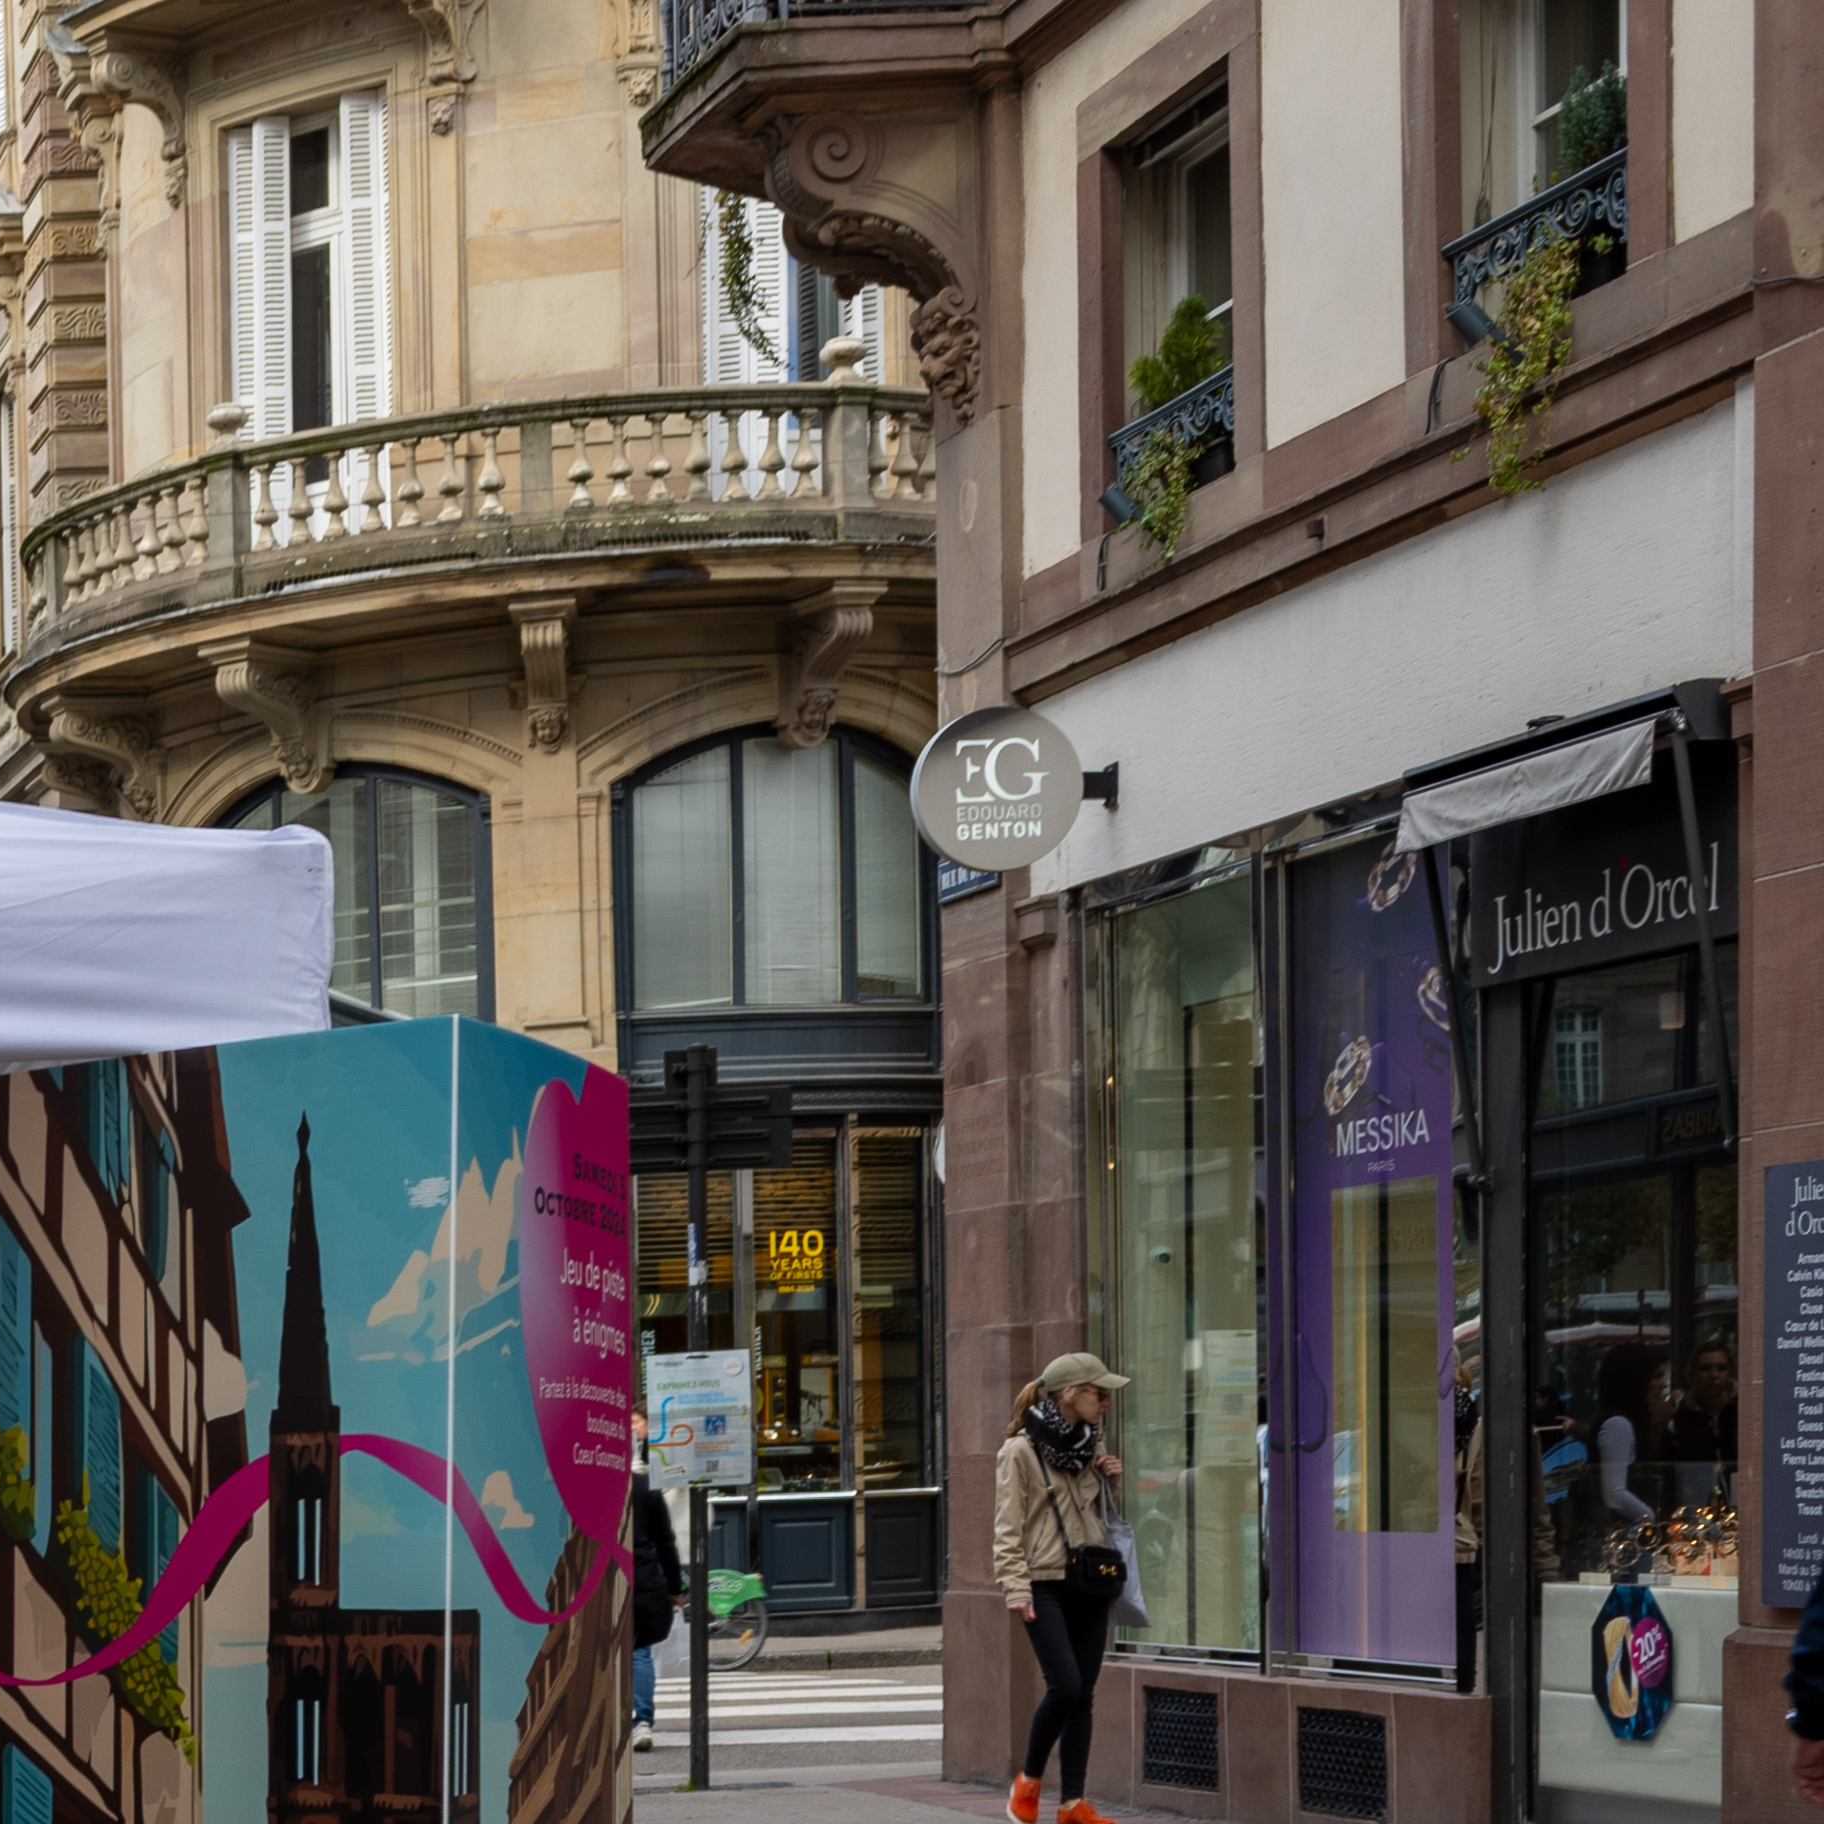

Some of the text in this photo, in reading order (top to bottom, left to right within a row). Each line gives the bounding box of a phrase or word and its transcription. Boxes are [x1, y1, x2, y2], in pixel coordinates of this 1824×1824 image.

[955, 804, 1042, 821] EDOUARD
[955, 821, 1042, 840] GENTON
[1488, 887, 1583, 974] Julien
[1335, 1108, 1430, 1158] MESSIKA
[1367, 1159, 1396, 1173] PARIS
[573, 1151, 617, 1197] SAMEDI
[534, 1185, 626, 1239] OCTOBRE 2024
[769, 1229, 824, 1258] 140
[770, 1257, 824, 1270] YEARS
[560, 1247, 626, 1303] Jeu de piste
[769, 1271, 824, 1281] OF FIRSTS
[1799, 1285, 1824, 1298] Casio
[1799, 1302, 1824, 1315] Cluse
[573, 1305, 626, 1359] à énigmes
[1798, 1352, 1823, 1365] Diesel
[1798, 1402, 1824, 1415] Fossil
[1797, 1419, 1824, 1432] Guess
[1780, 1437, 1795, 1449] Les
[1797, 1503, 1823, 1516] Tissot
